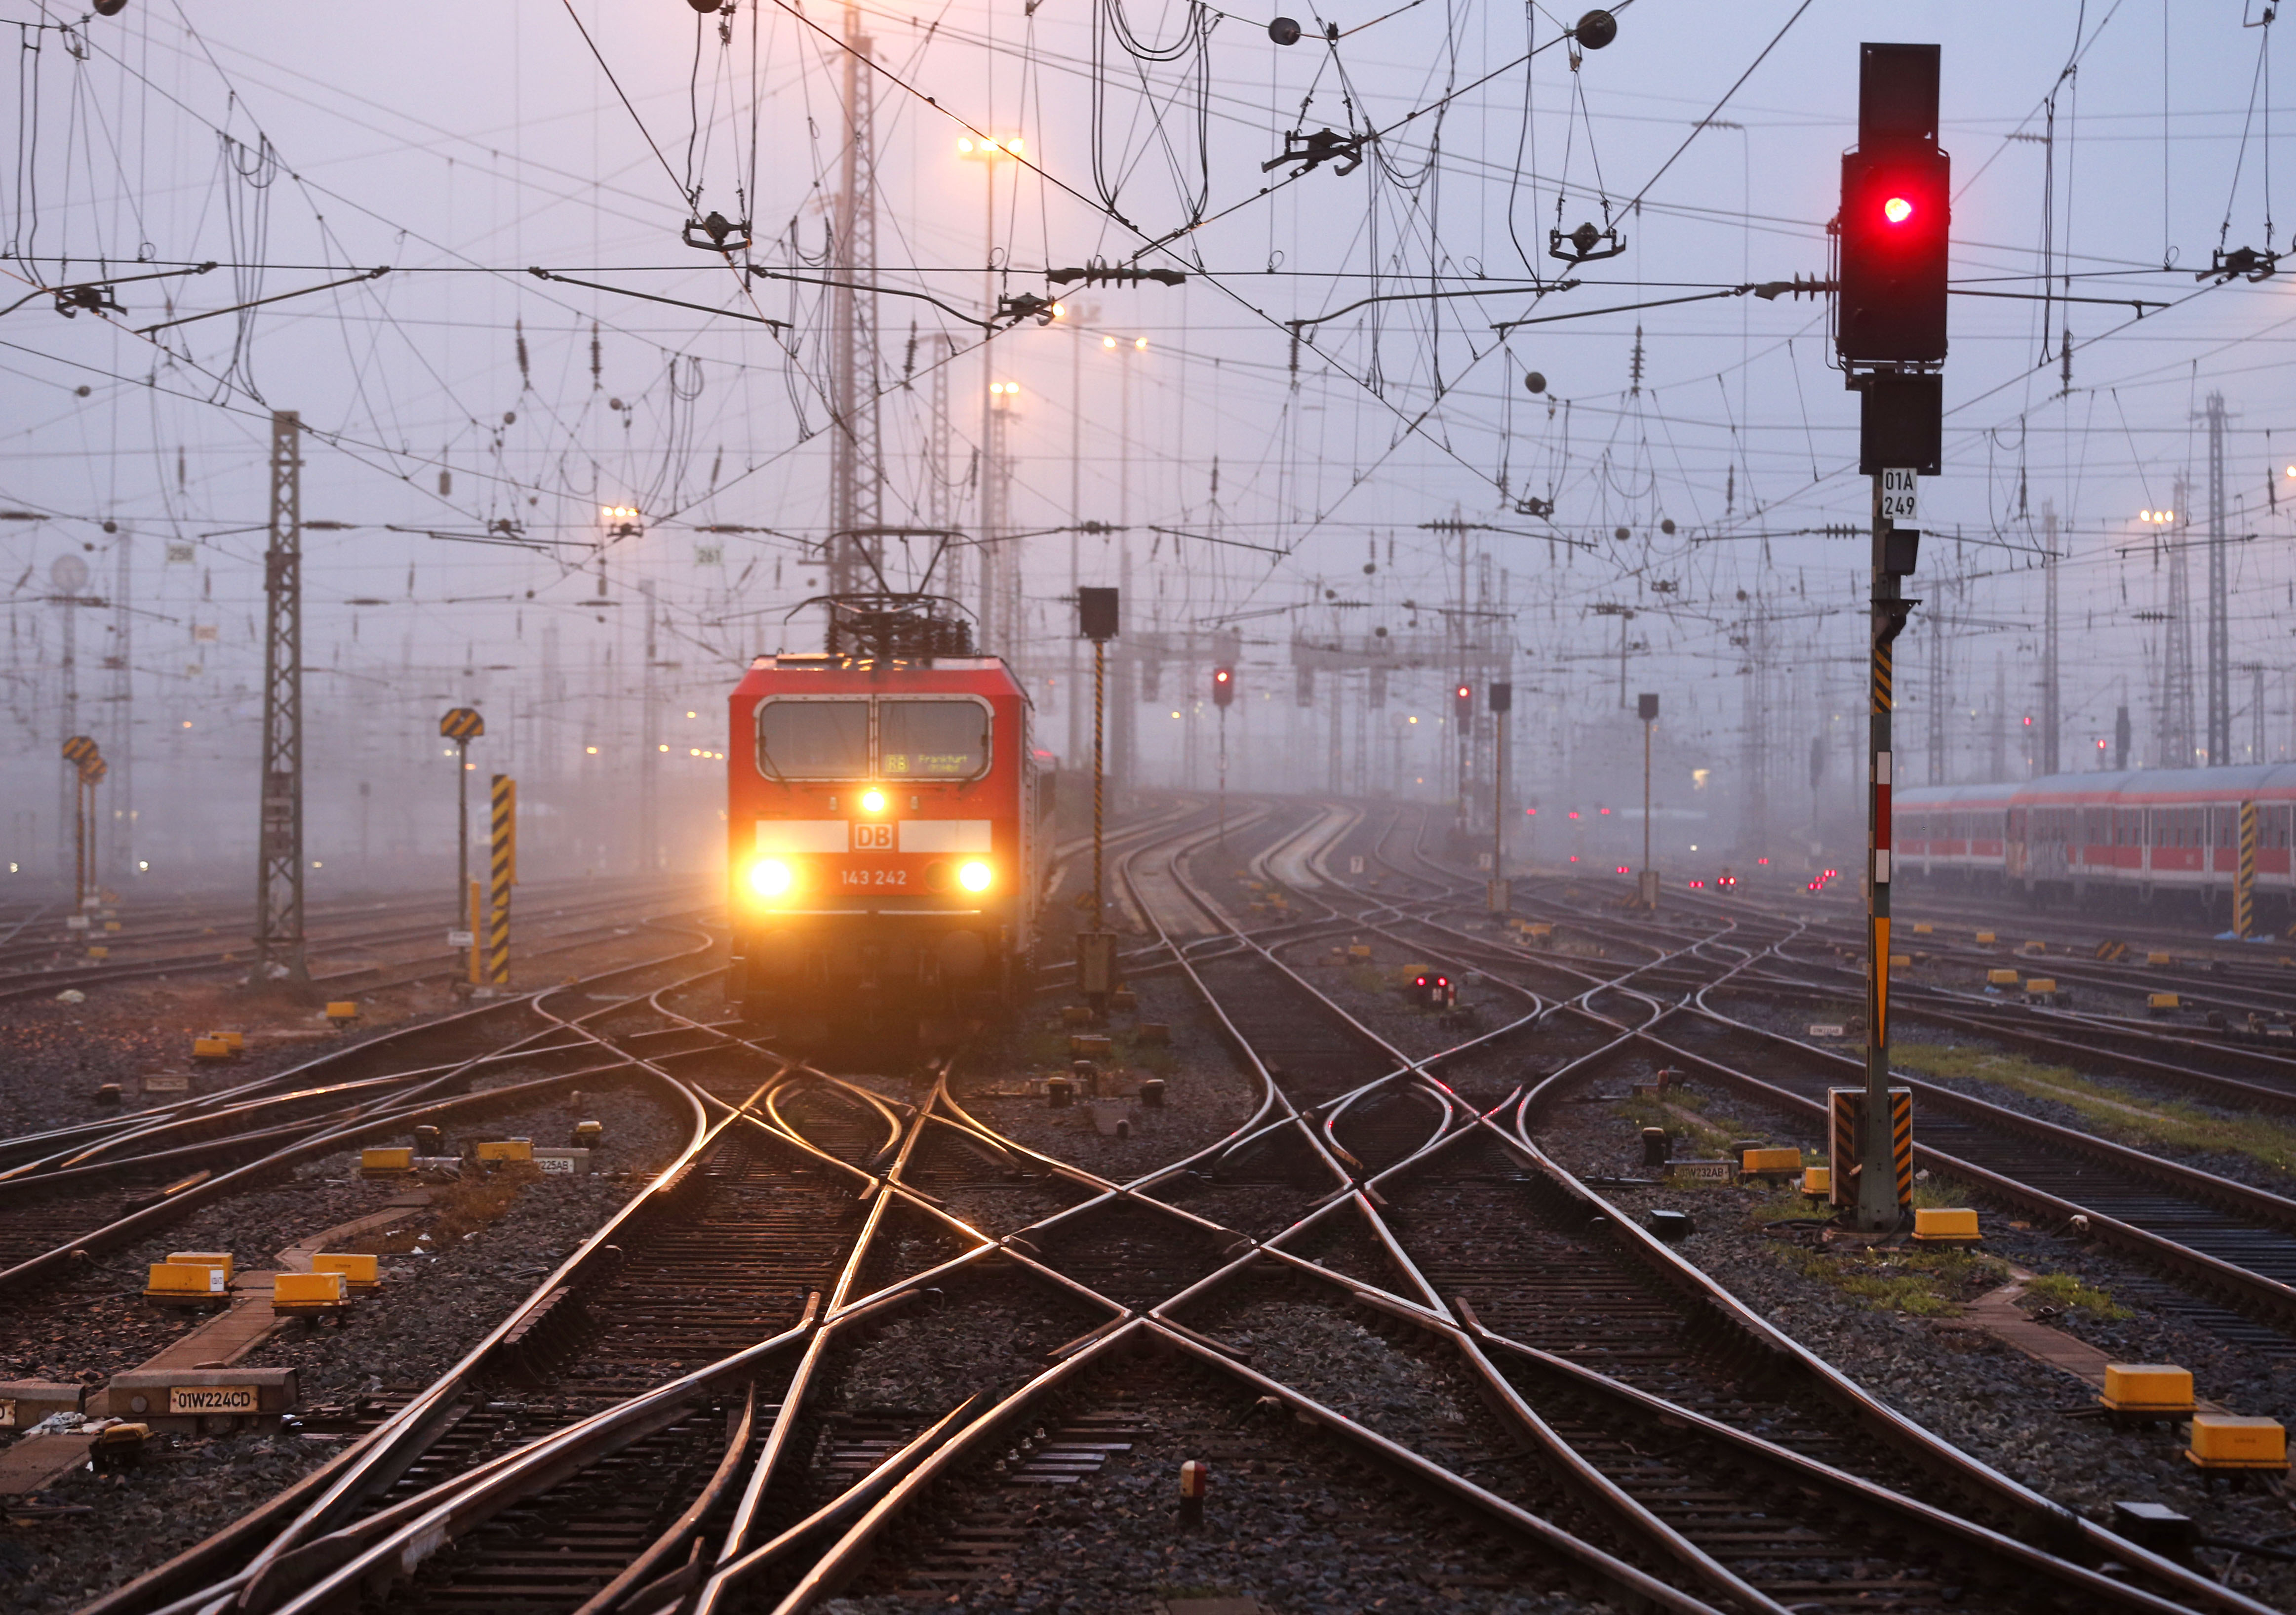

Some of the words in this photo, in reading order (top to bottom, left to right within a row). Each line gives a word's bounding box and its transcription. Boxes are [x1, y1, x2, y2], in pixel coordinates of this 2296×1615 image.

[1885, 472, 1914, 490] 01A
[1885, 496, 1914, 515] 249
[857, 825, 891, 847] DB
[841, 870, 869, 885] 143
[874, 870, 907, 885] 242
[539, 1160, 569, 1170] 225AB
[178, 1392, 250, 1408] 01W224CD
